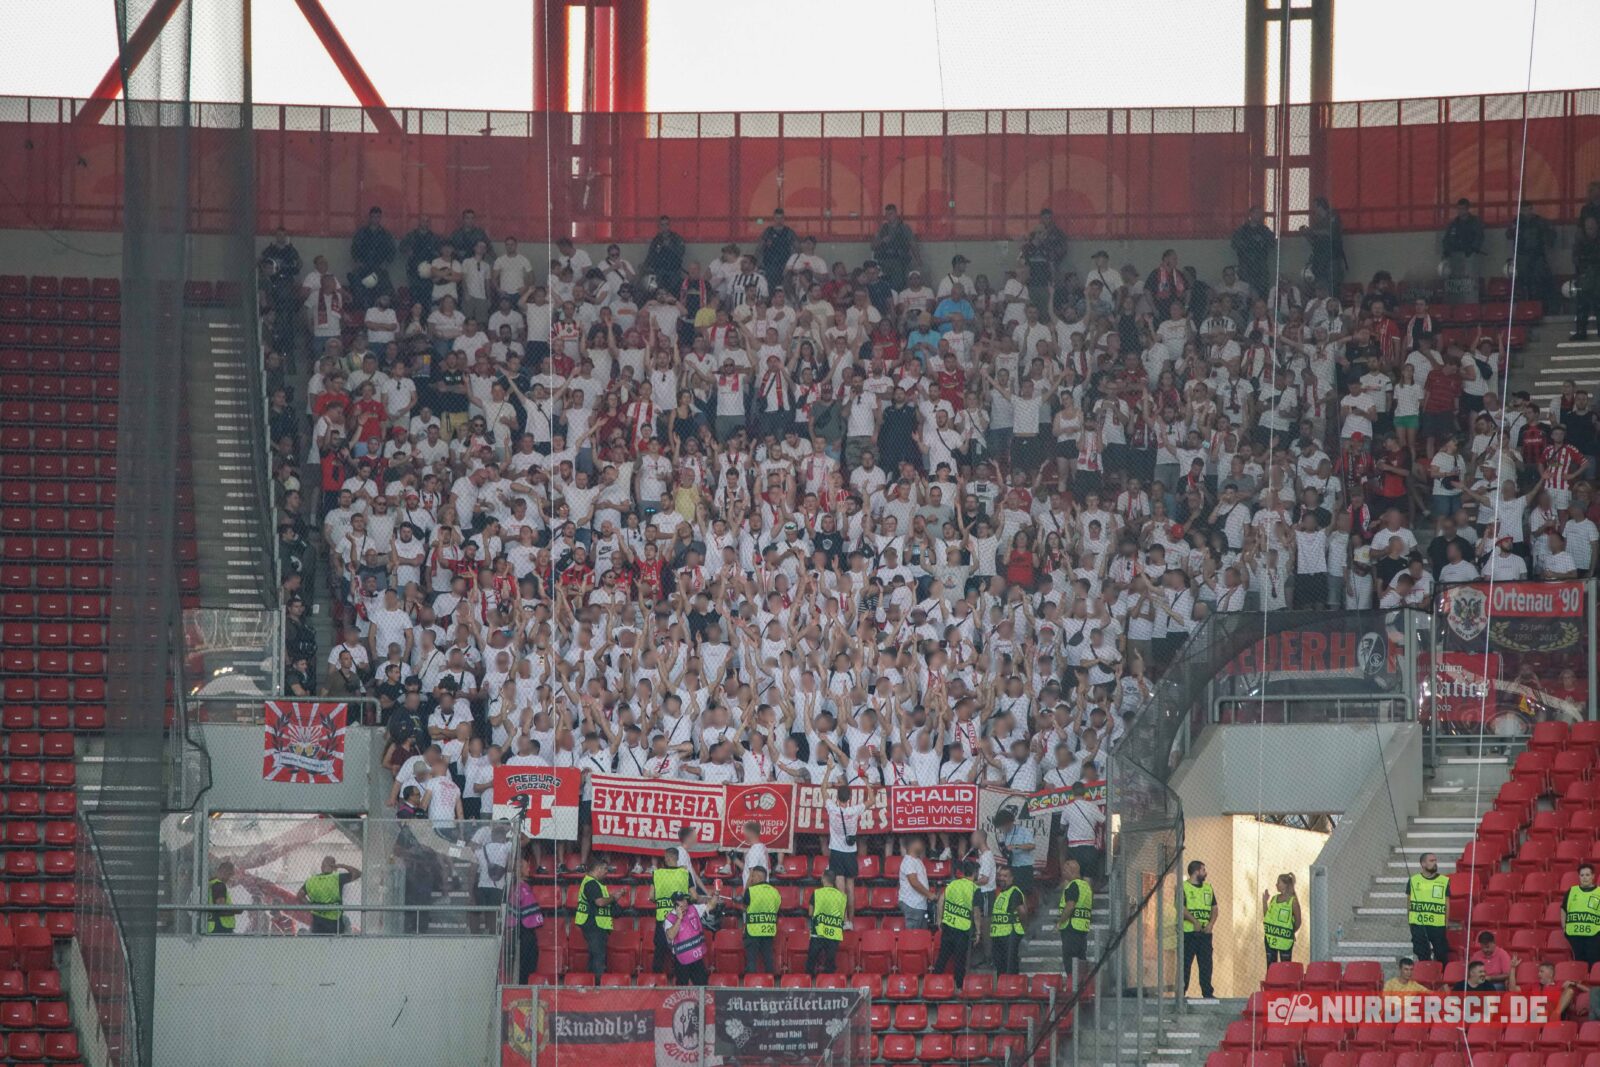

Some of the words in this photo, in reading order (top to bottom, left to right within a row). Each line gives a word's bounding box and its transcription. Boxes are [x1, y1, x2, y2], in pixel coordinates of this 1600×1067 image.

[1493, 587, 1553, 612] Ortenau
[1558, 587, 1580, 612] '90
[593, 788, 719, 818] SYNTHESIA
[896, 789, 973, 803] KHALID
[896, 804, 925, 815] FÜR
[928, 805, 974, 815] IMMER
[797, 808, 889, 830] ULAS
[907, 816, 929, 826] BEI
[932, 816, 963, 826] UNS
[598, 815, 682, 839] ULTRAS
[689, 822, 715, 841] 79
[1411, 903, 1446, 913] TEWARD
[749, 914, 776, 923] STEWA
[1417, 914, 1435, 923] 056
[1264, 924, 1292, 938] EWARD
[1574, 924, 1592, 933] 286
[726, 995, 849, 1014] Markgräflerland
[555, 1014, 647, 1040] Knaddly's
[775, 1031, 788, 1039] und
